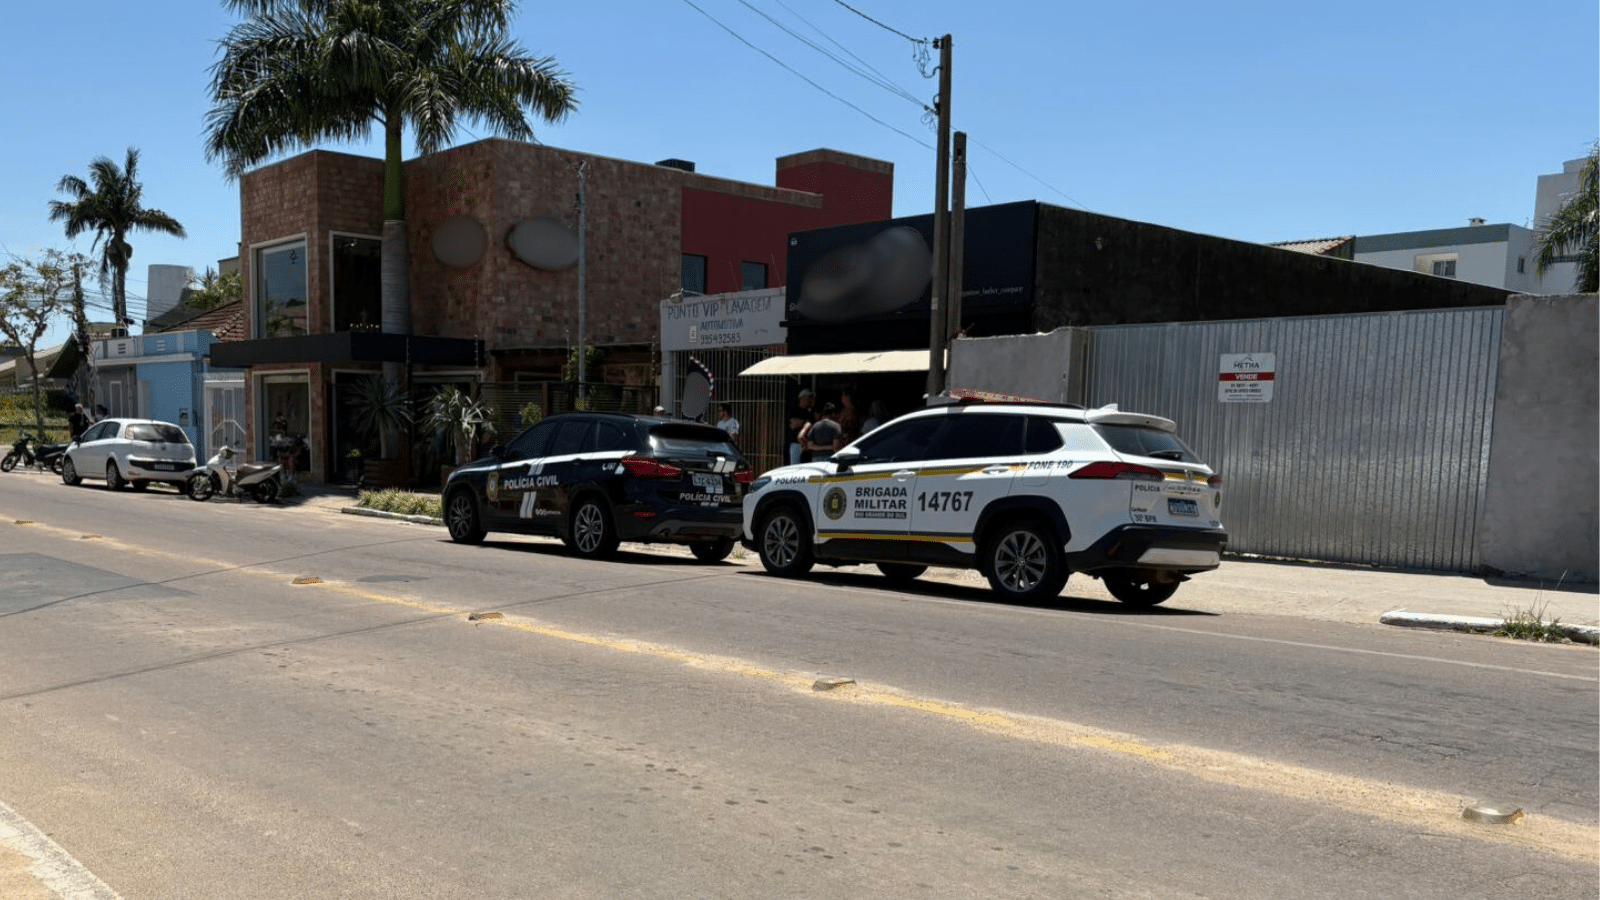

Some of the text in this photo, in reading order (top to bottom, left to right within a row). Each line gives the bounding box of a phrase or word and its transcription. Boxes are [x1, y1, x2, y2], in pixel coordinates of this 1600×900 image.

[1027, 460, 1074, 470] FONE 190
[504, 475, 559, 490] POLÍCIA CIVIL
[680, 491, 732, 503] POLÍCIA CIVIL
[855, 486, 907, 497] BRIGADA
[854, 499, 907, 509] MILITAR
[917, 491, 974, 512] 14767
